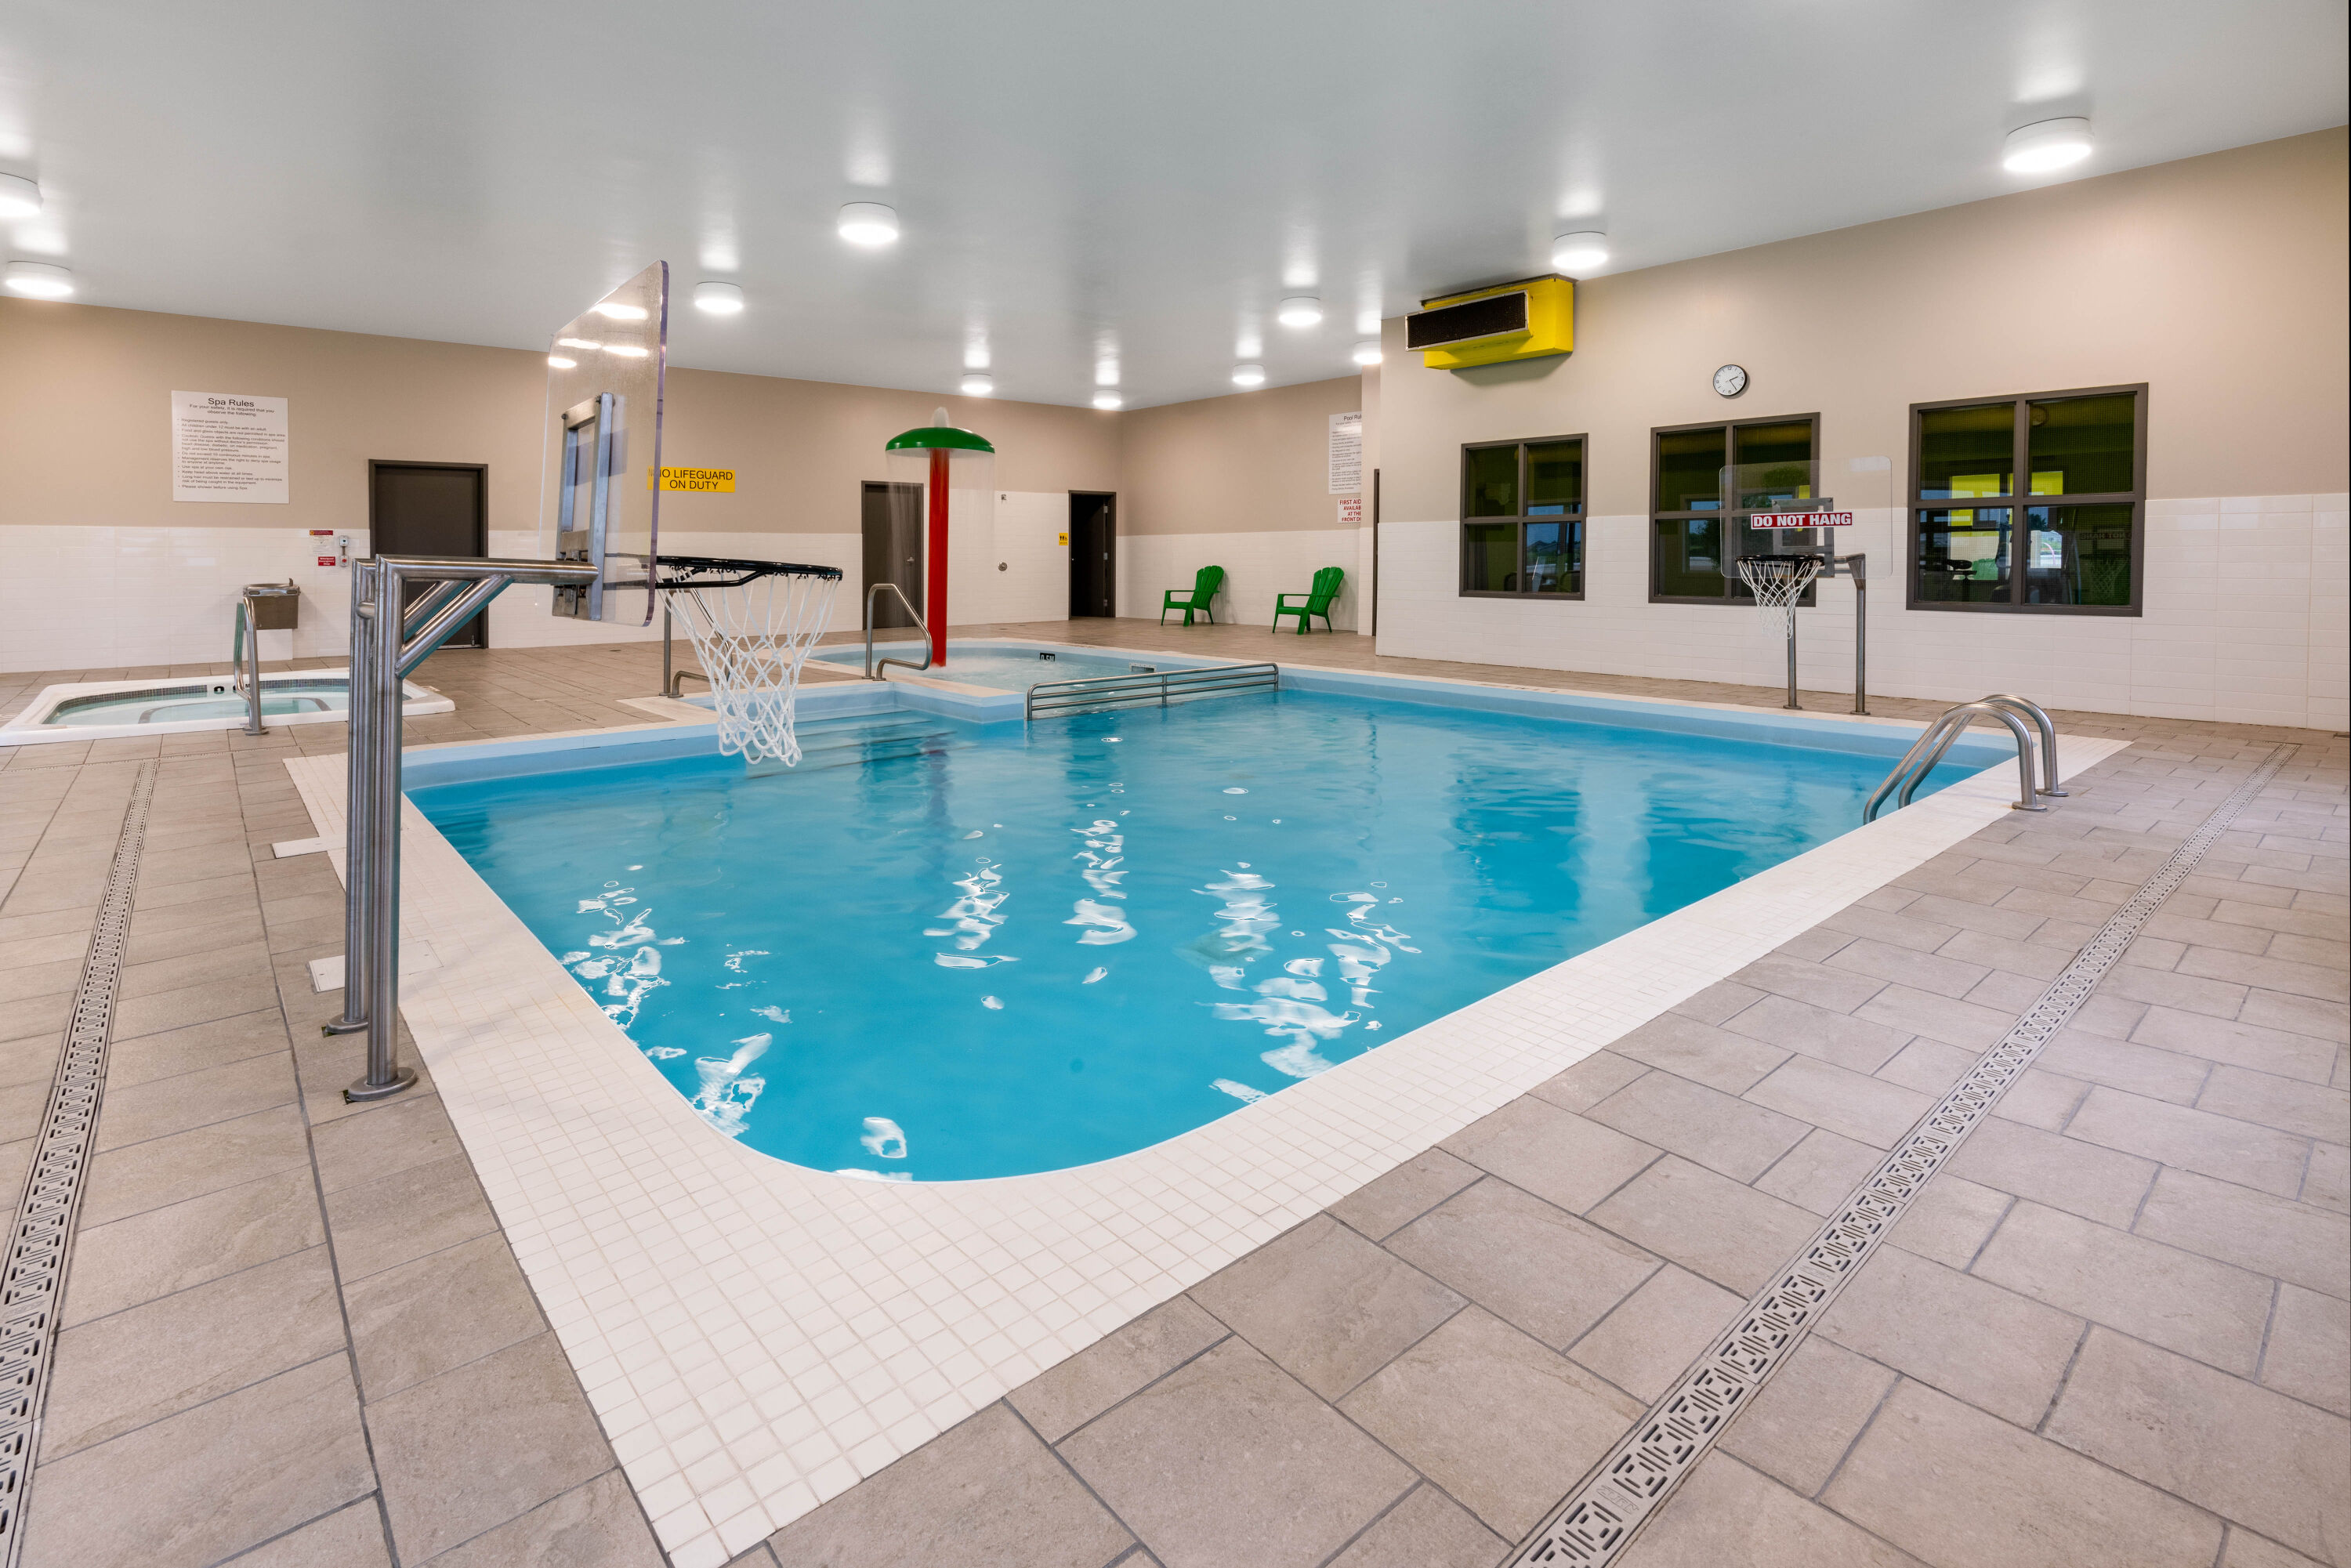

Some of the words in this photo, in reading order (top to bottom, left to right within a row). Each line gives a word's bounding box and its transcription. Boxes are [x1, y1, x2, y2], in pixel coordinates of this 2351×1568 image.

[208, 398, 226, 406] Spa
[674, 470, 733, 480] LIFEGUARD
[670, 480, 686, 489] ON
[689, 481, 718, 490] DUTY
[1753, 516, 1772, 527] DO
[1777, 515, 1805, 526] NOT
[1809, 514, 1851, 525] HANG
